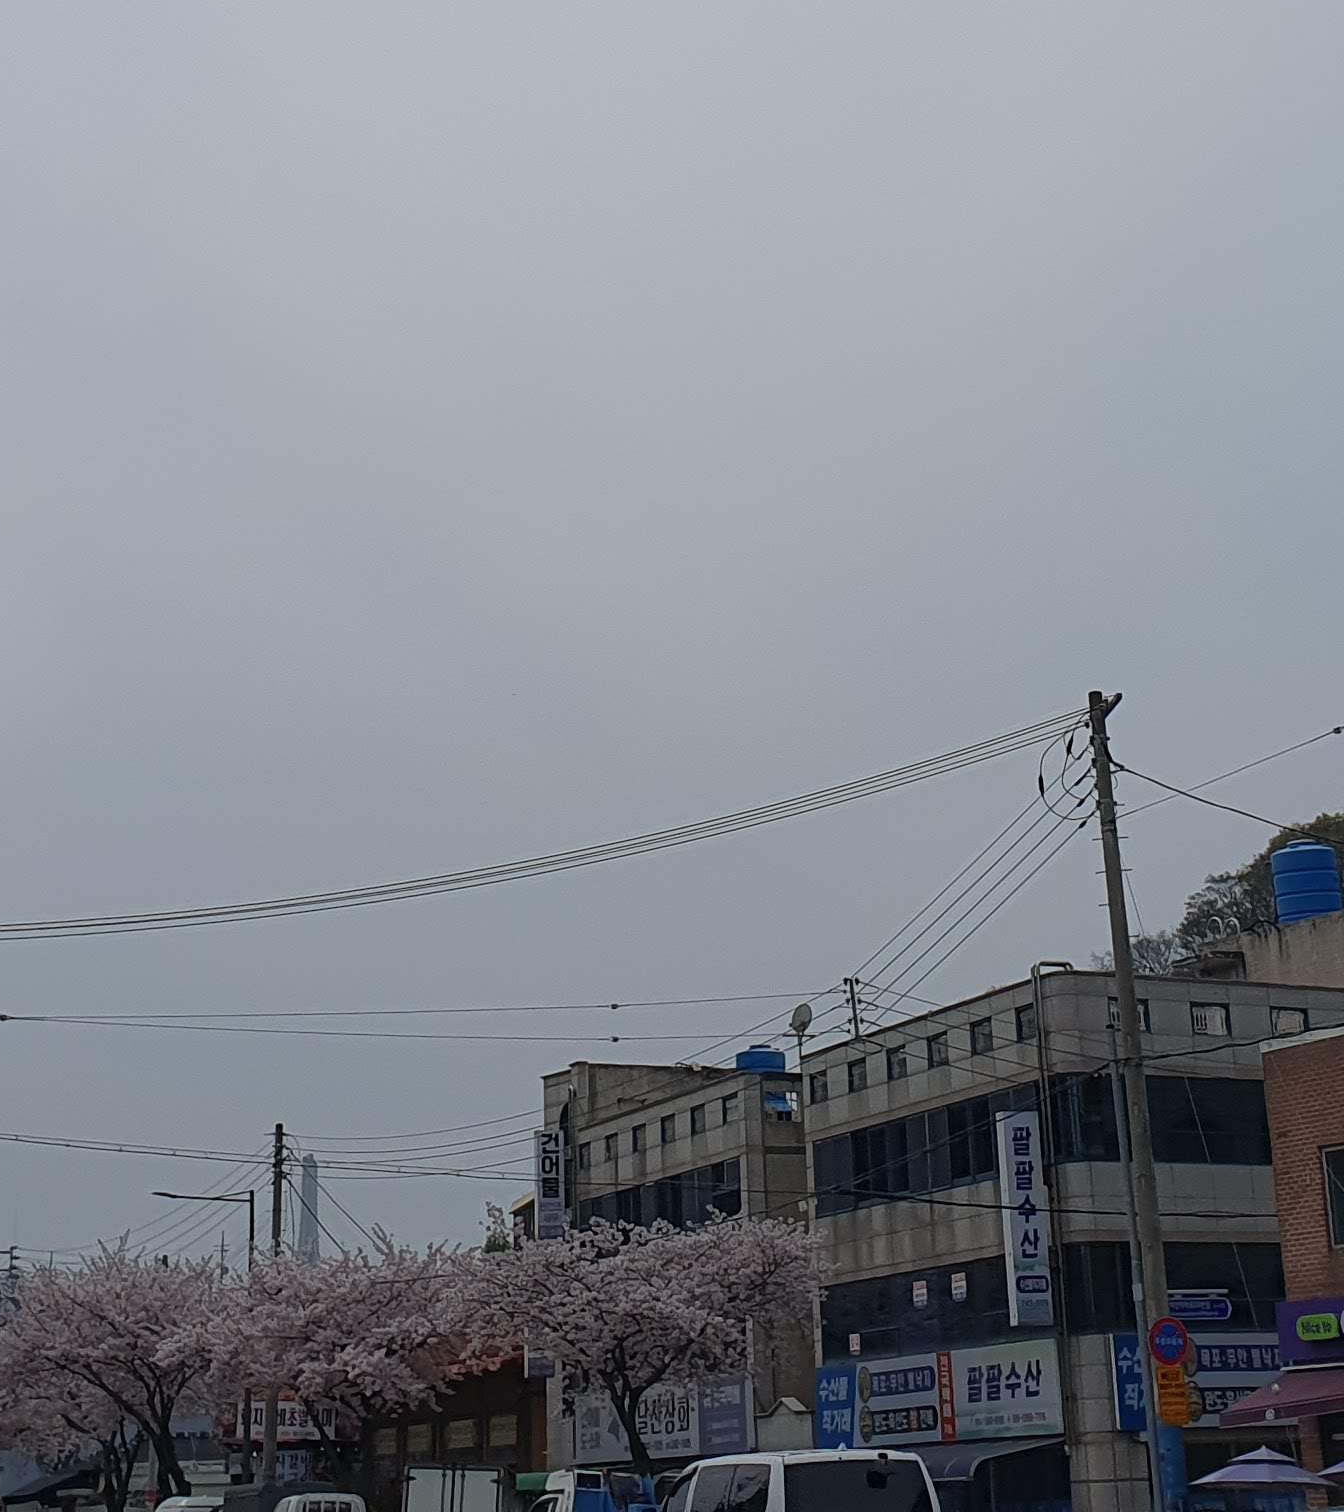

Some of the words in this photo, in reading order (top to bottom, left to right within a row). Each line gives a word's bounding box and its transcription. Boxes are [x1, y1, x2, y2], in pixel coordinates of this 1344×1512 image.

[541, 1133, 560, 1198] 건어물
[1011, 1125, 1040, 1259] 팔팔수산
[967, 1360, 1042, 1403] 팔팔수산
